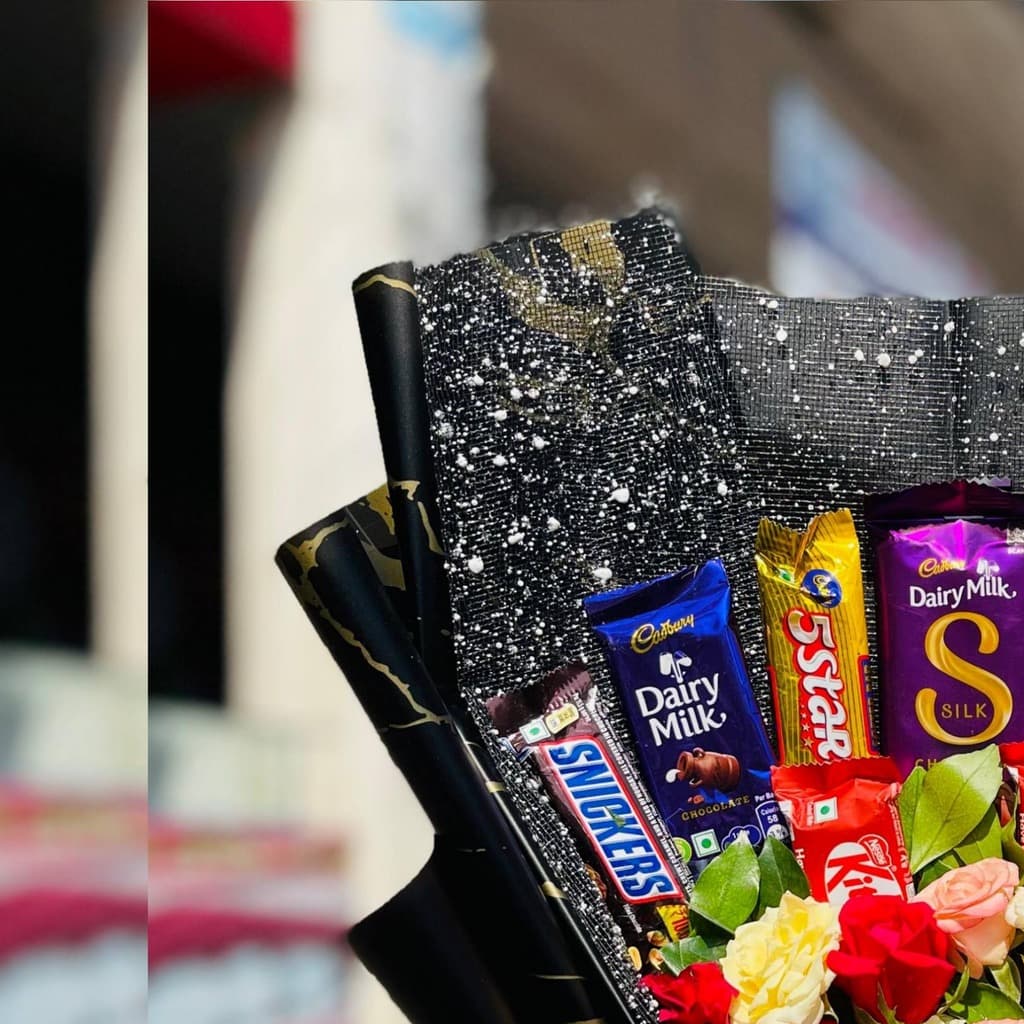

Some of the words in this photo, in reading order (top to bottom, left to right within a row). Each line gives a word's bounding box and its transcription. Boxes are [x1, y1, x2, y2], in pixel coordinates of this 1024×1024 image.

[910, 585, 965, 609] Dairy
[966, 576, 1017, 600] Milk
[631, 614, 694, 654] Cadbury
[635, 673, 719, 718] Dairy
[942, 703, 987, 719] SILK
[648, 704, 727, 746] Milk
[550, 742, 675, 897] SNICKERS
[681, 794, 751, 821] CHOCOLATE
[767, 814, 779, 823] 58
